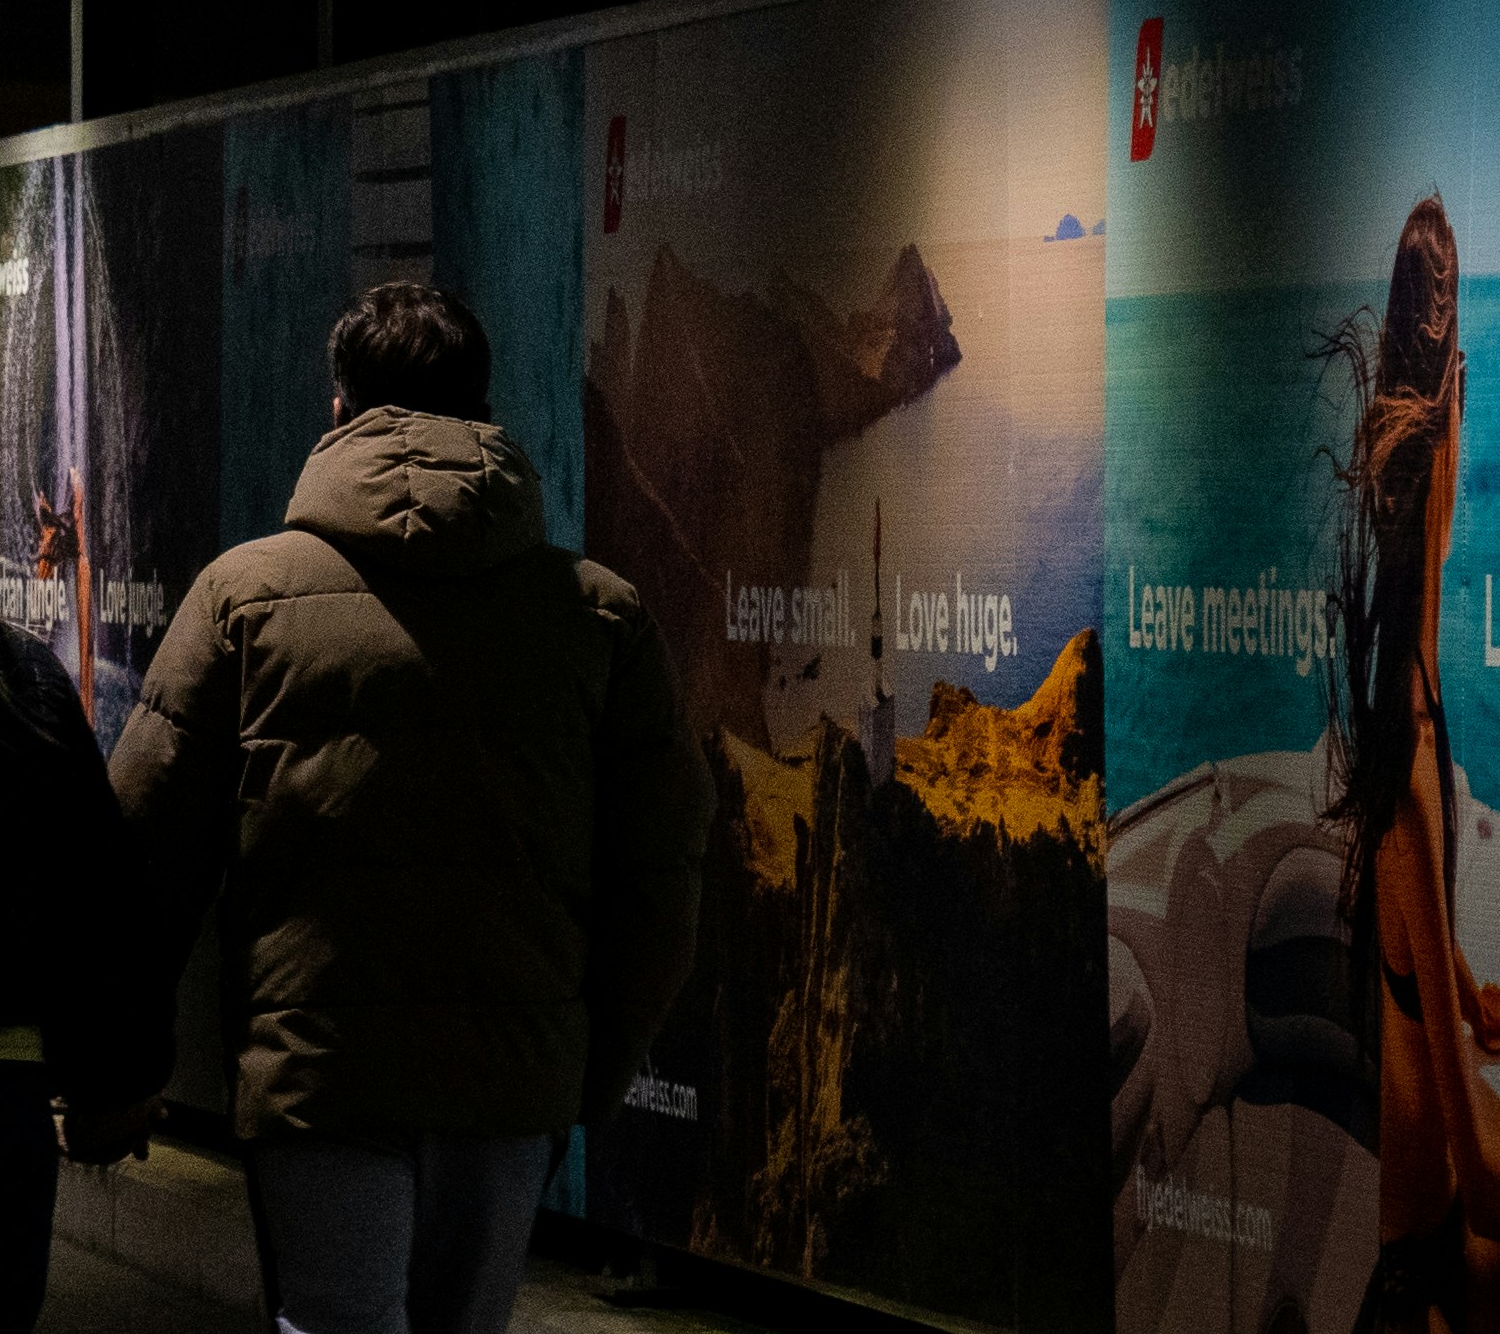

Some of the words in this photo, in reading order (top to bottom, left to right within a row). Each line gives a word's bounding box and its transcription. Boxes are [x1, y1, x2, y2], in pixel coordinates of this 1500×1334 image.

[1163, 39, 1302, 121] edelweiss
[100, 568, 126, 624] Love
[726, 568, 785, 644] Leave
[791, 569, 856, 648] small.
[896, 575, 949, 653] Love
[956, 573, 1019, 672] huge.
[1128, 566, 1196, 652] Leave
[1202, 566, 1337, 678] meetings.
[1136, 1164, 1274, 1251] flyedelweiss.com
